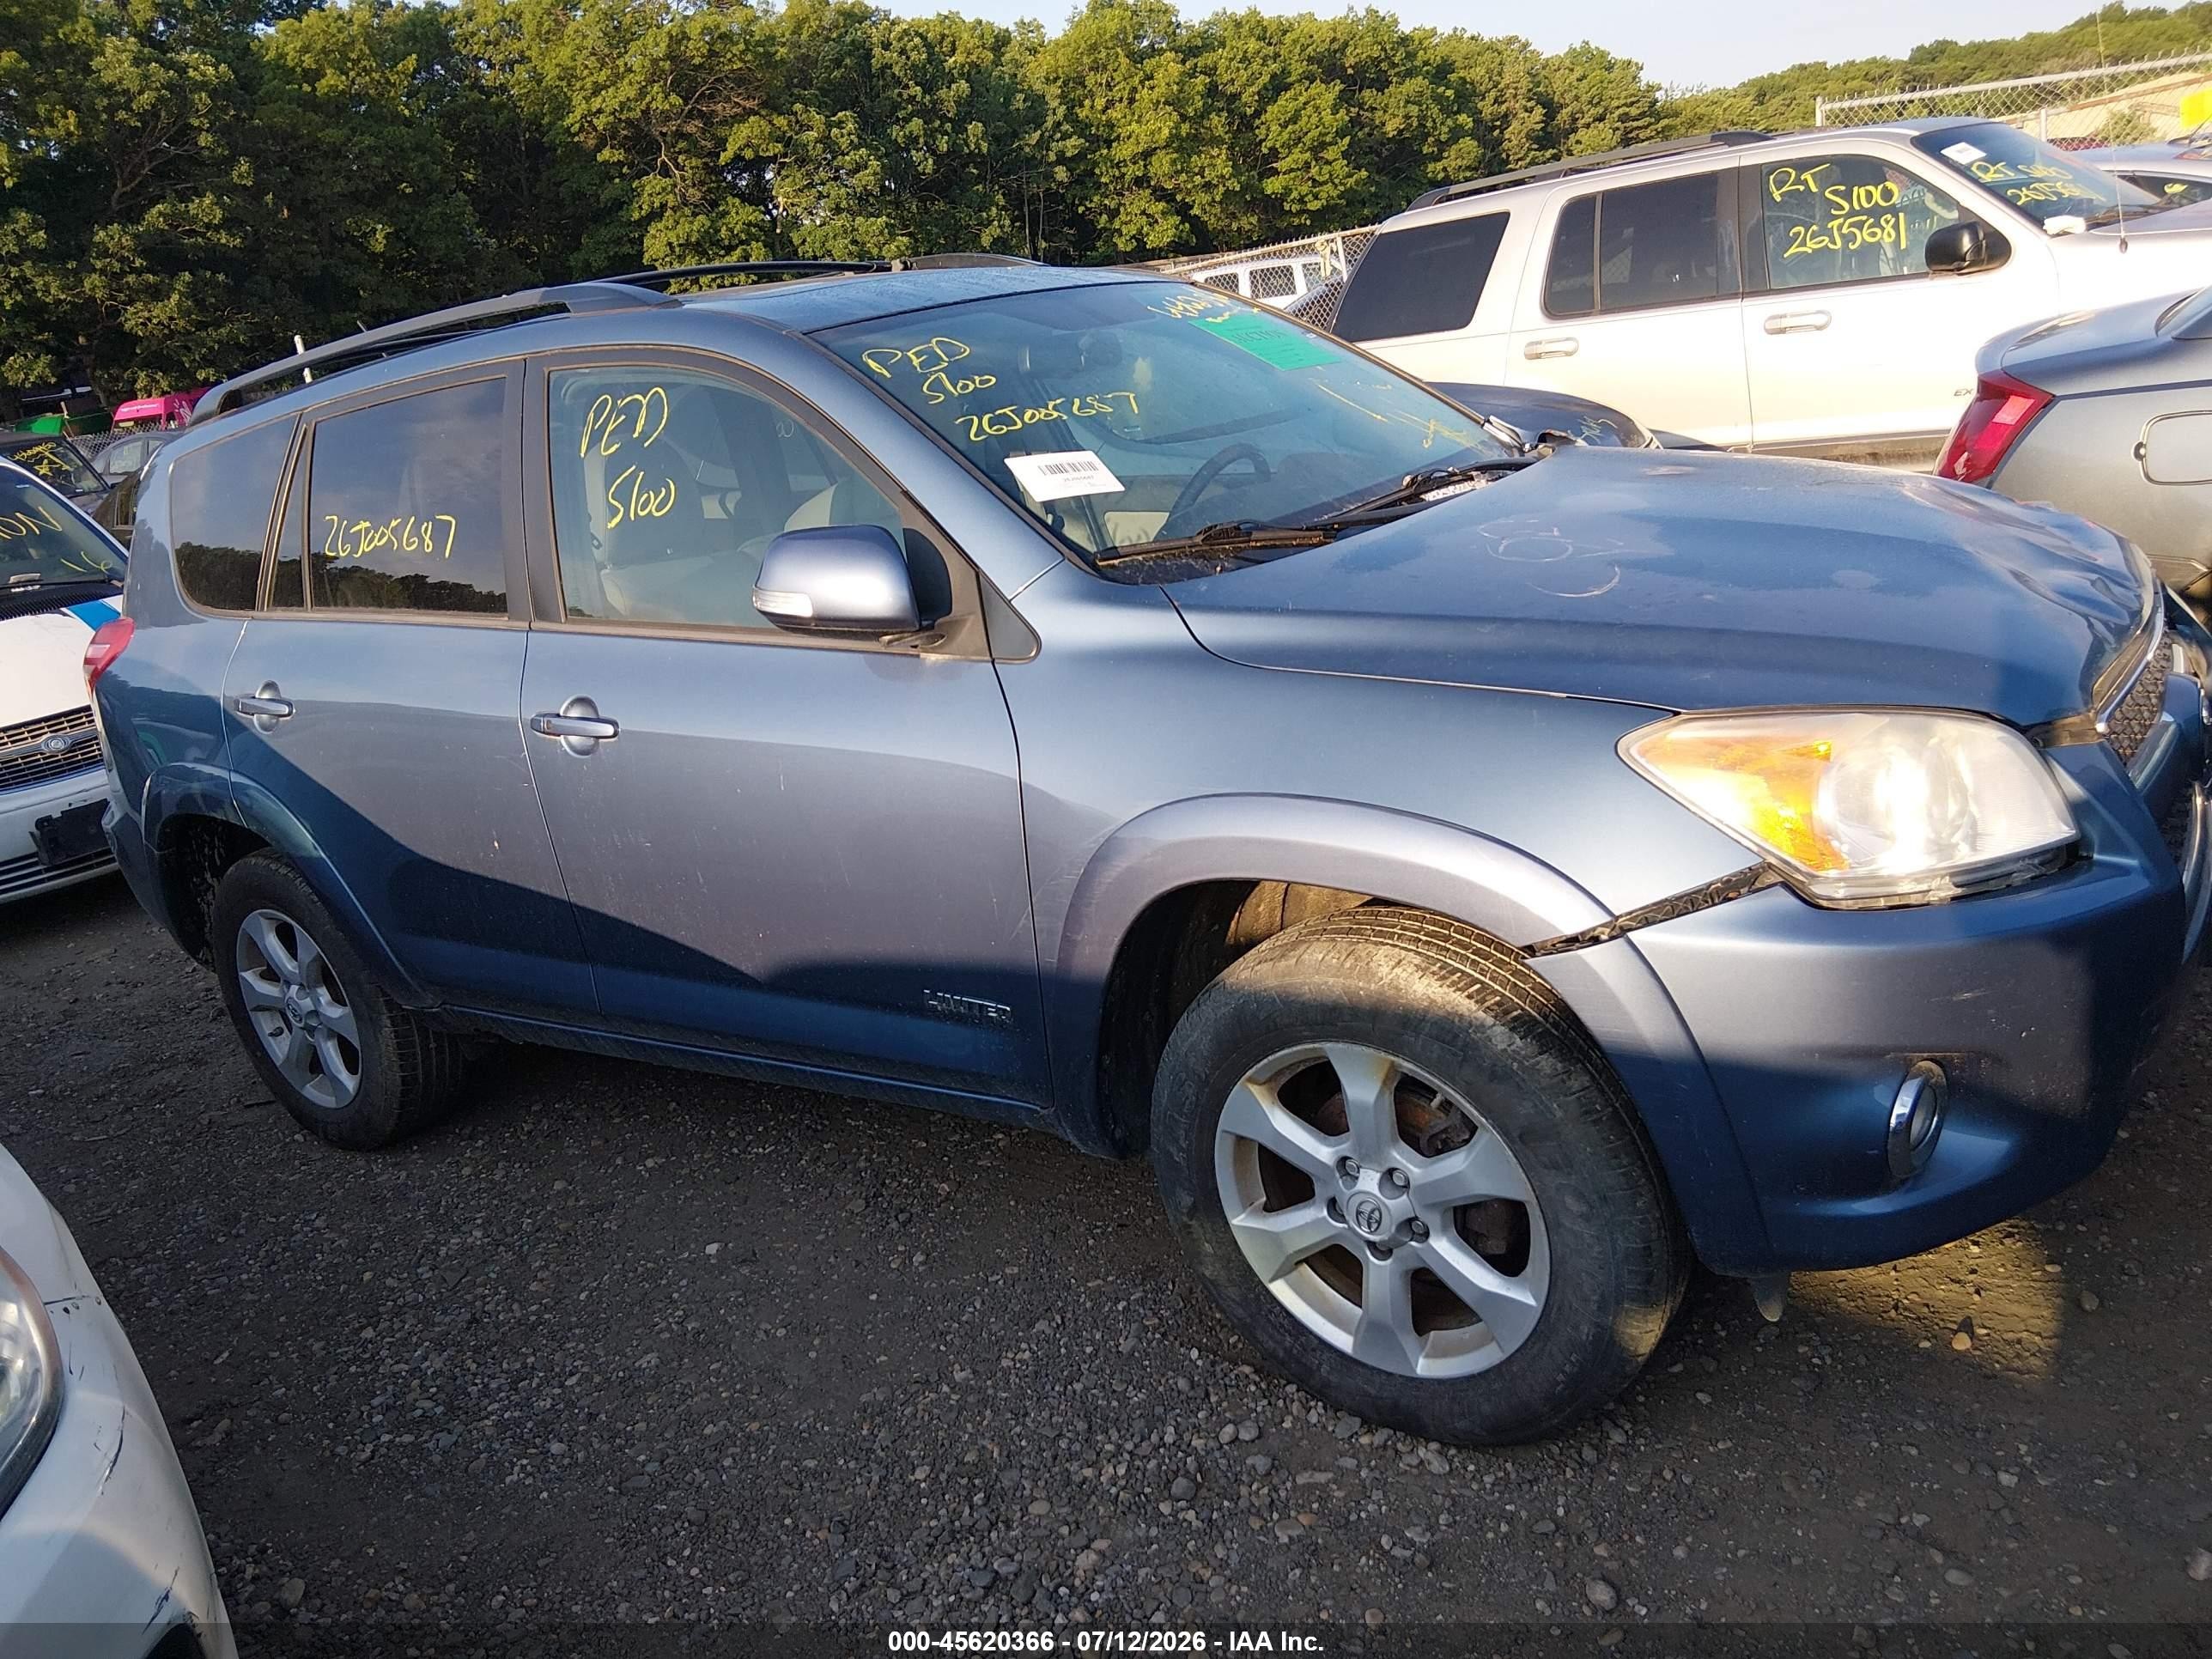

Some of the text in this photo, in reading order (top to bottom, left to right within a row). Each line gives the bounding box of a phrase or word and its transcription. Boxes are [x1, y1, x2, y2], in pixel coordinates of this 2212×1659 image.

[1769, 163, 1832, 203] RT
[1824, 181, 1899, 216] S100
[1784, 213, 1908, 258] 26J5681
[862, 337, 970, 378] PED
[580, 386, 669, 458] PED
[324, 515, 458, 558] 26J005687
